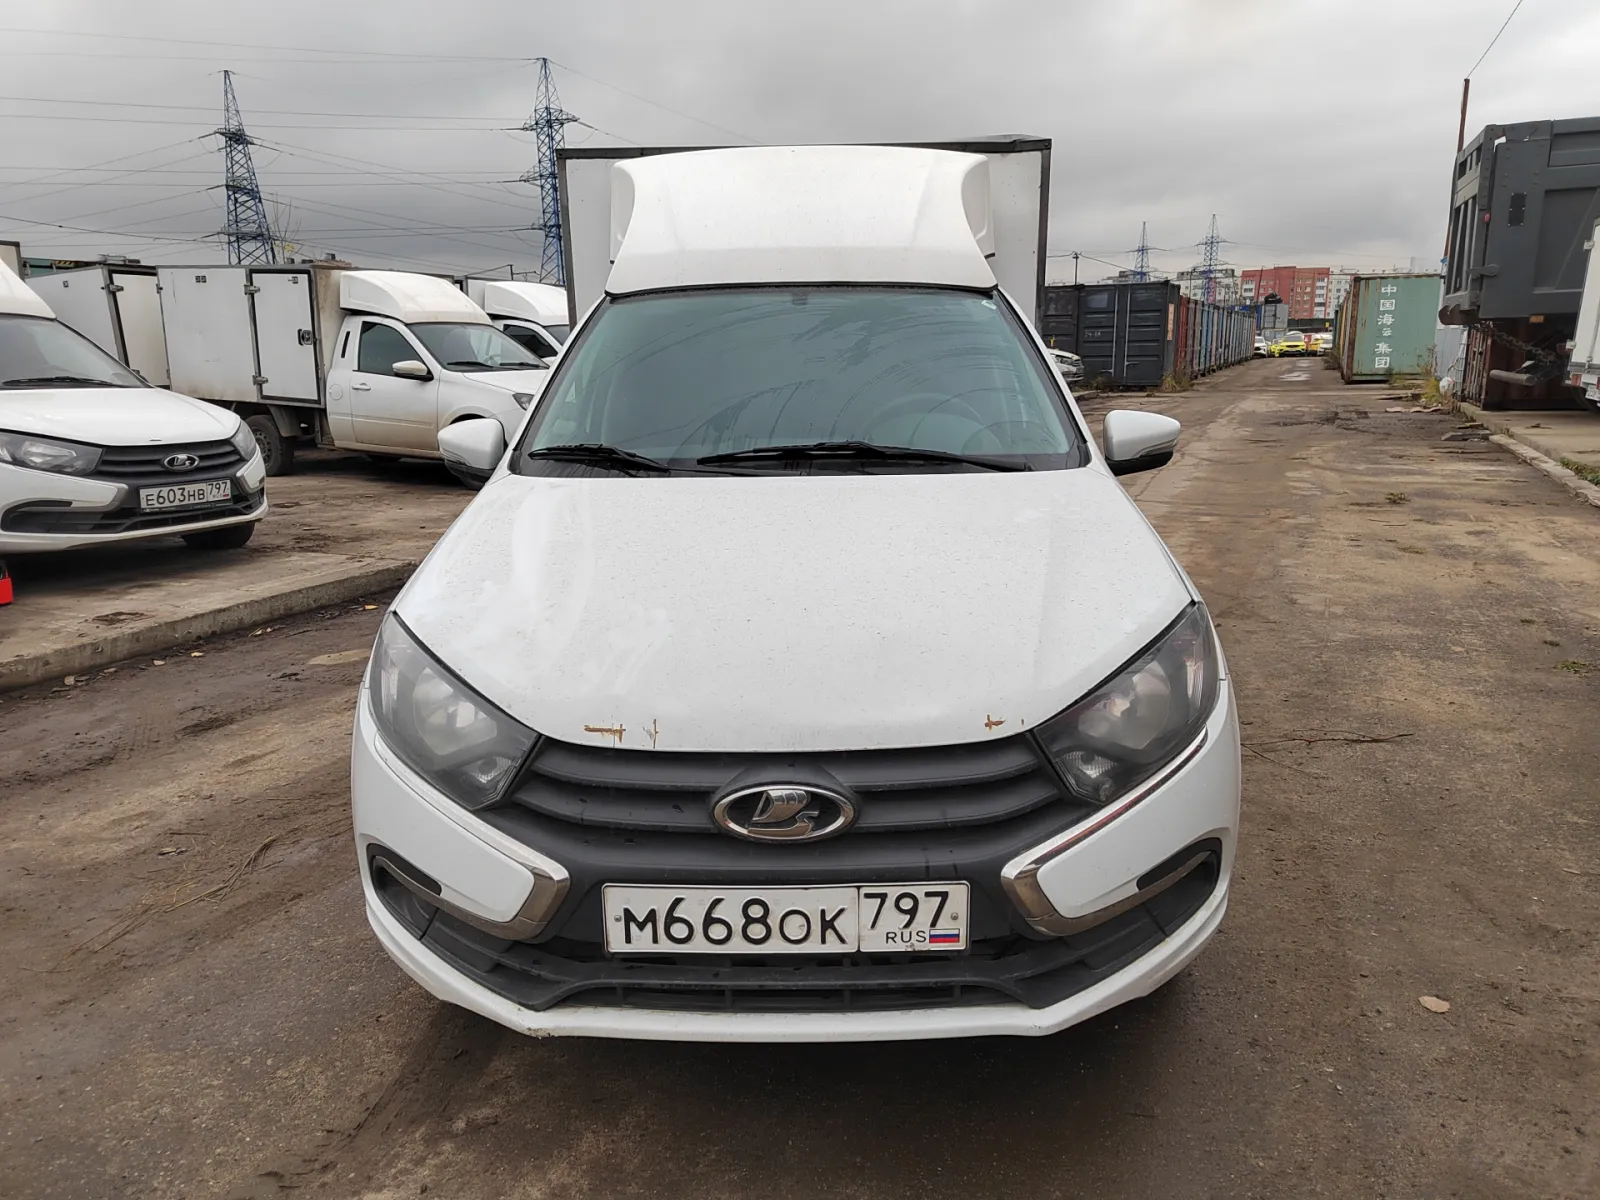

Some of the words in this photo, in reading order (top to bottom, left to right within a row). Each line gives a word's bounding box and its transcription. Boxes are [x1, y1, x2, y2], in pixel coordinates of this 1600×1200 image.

[145, 487, 206, 507] Е603НВ
[207, 481, 228, 496] 797
[622, 896, 848, 946] М668ОК
[863, 890, 950, 930] 797
[885, 930, 927, 944] RUS
